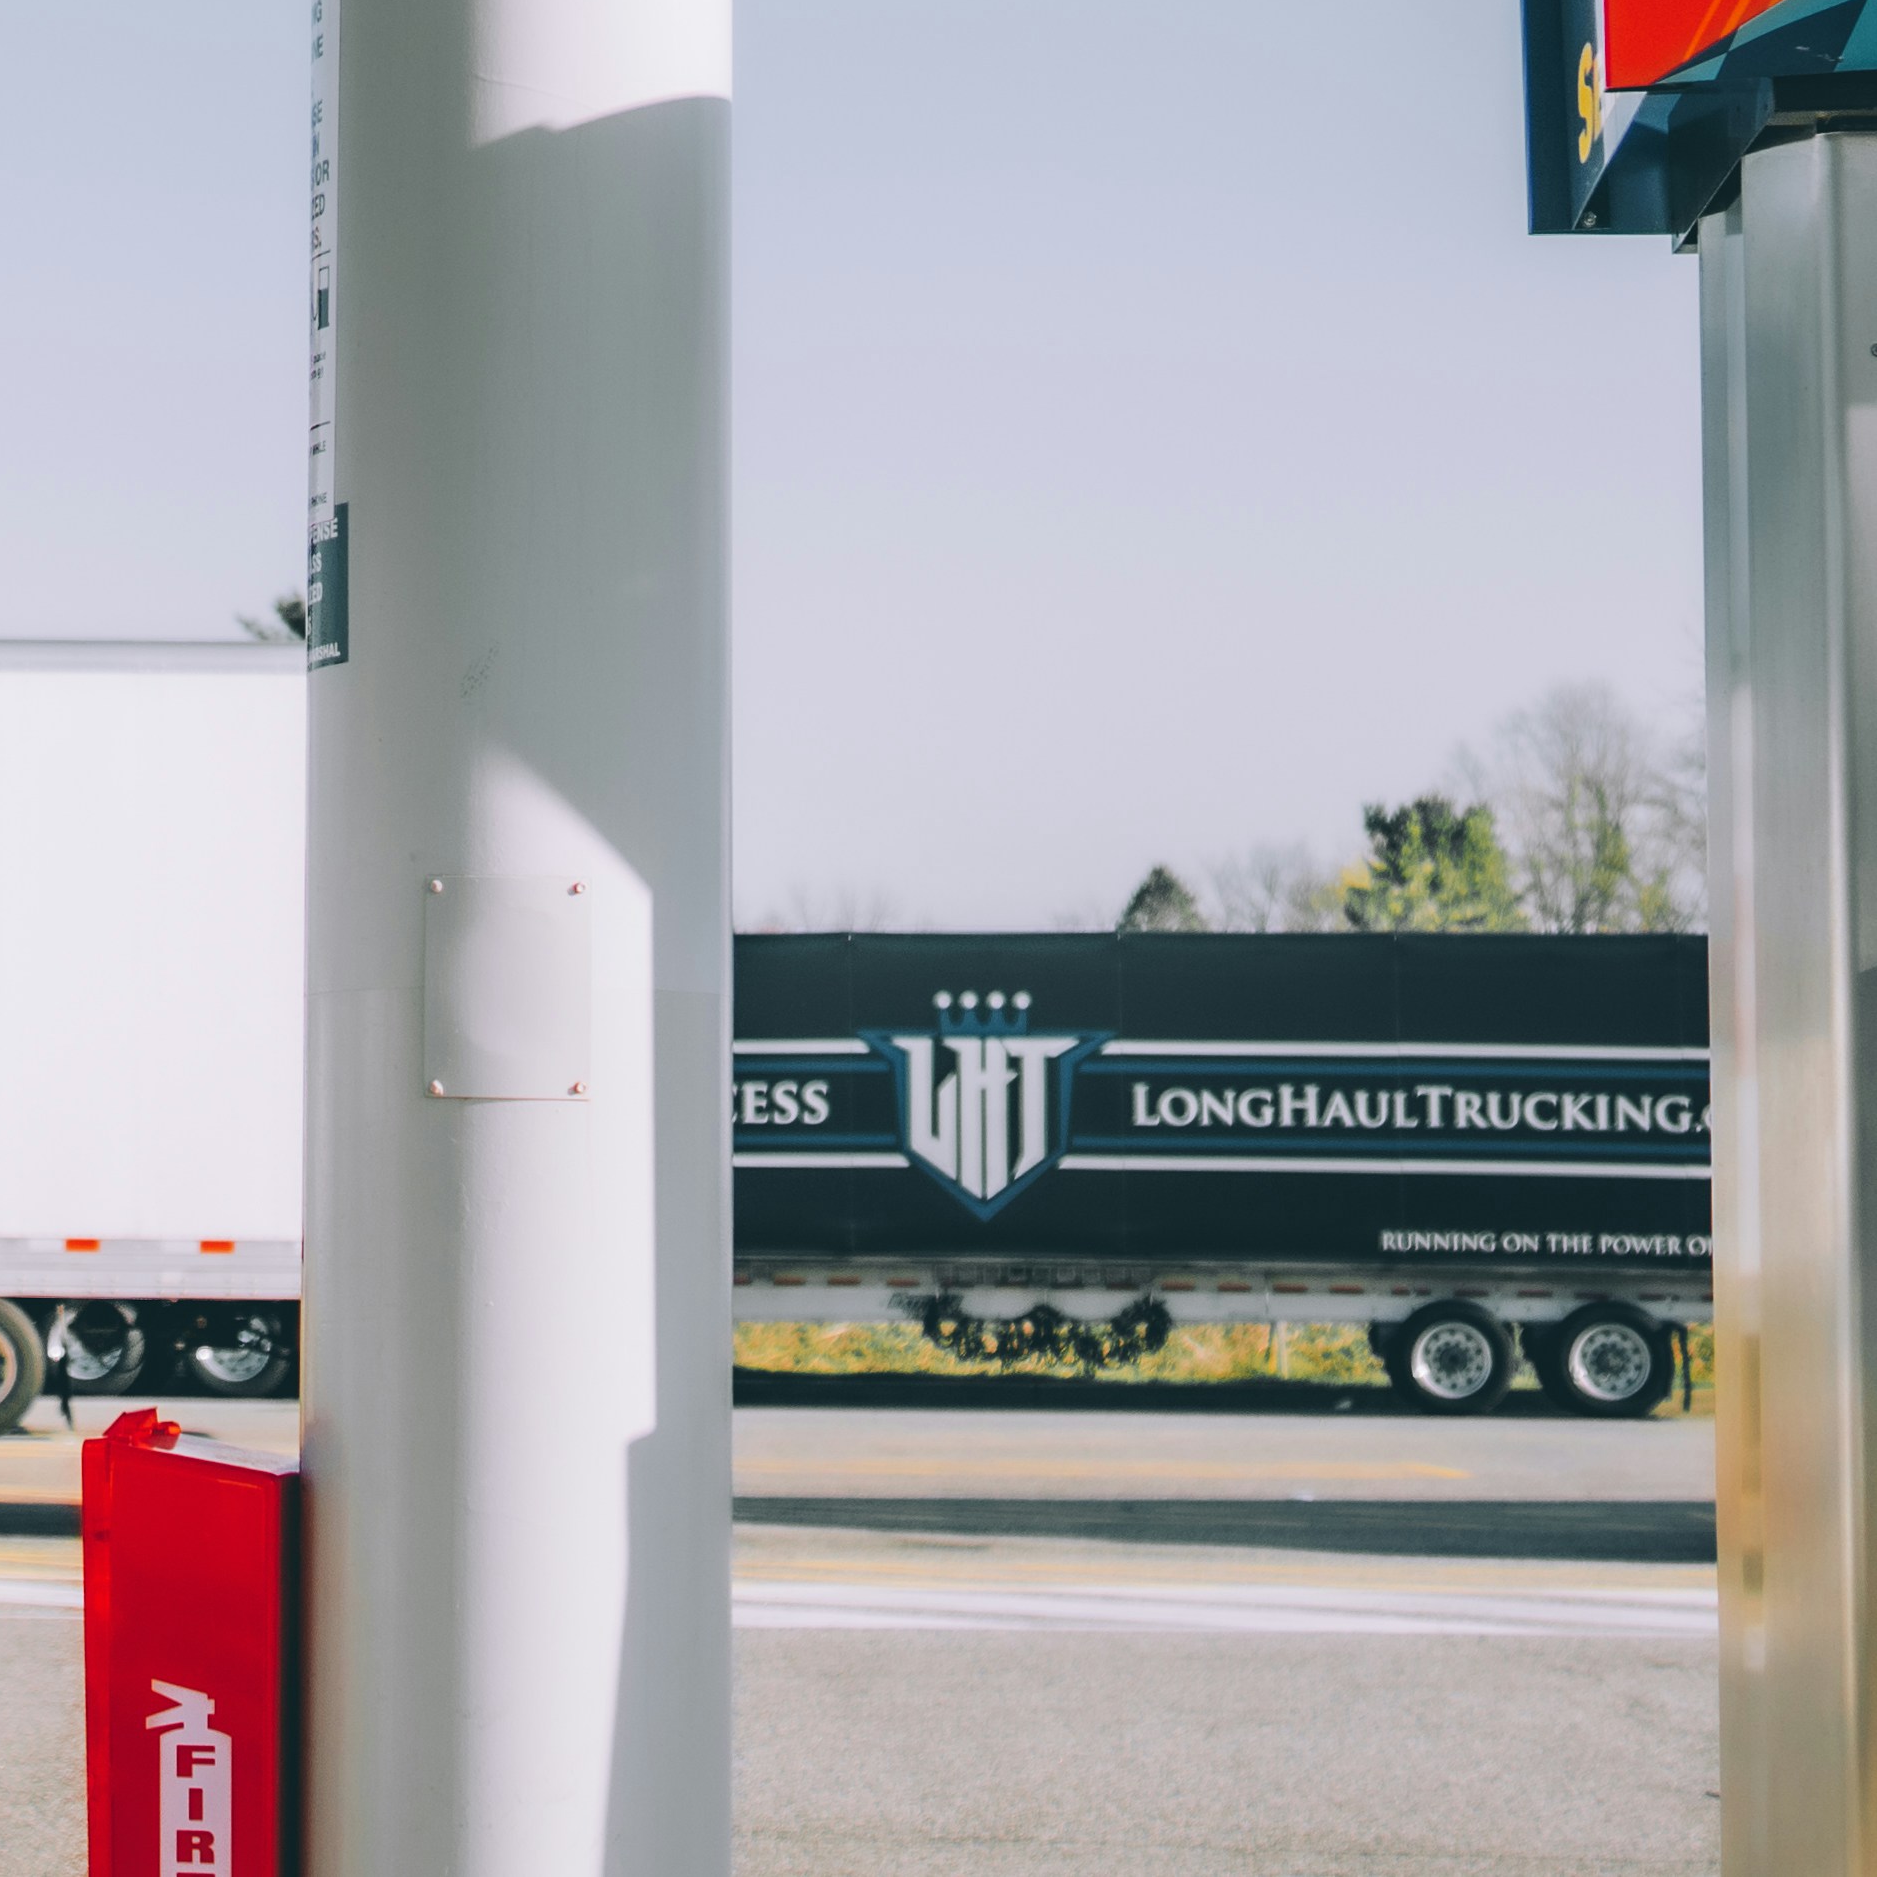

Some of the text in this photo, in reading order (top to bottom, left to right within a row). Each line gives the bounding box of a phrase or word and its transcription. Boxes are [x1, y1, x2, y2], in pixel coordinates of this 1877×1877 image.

[1380, 1229, 1496, 1253] RUNNING
[1502, 1232, 1539, 1253] ON
[1546, 1232, 1593, 1254] THE
[1600, 1233, 1681, 1255] POWER
[175, 1744, 216, 1877] FIR
